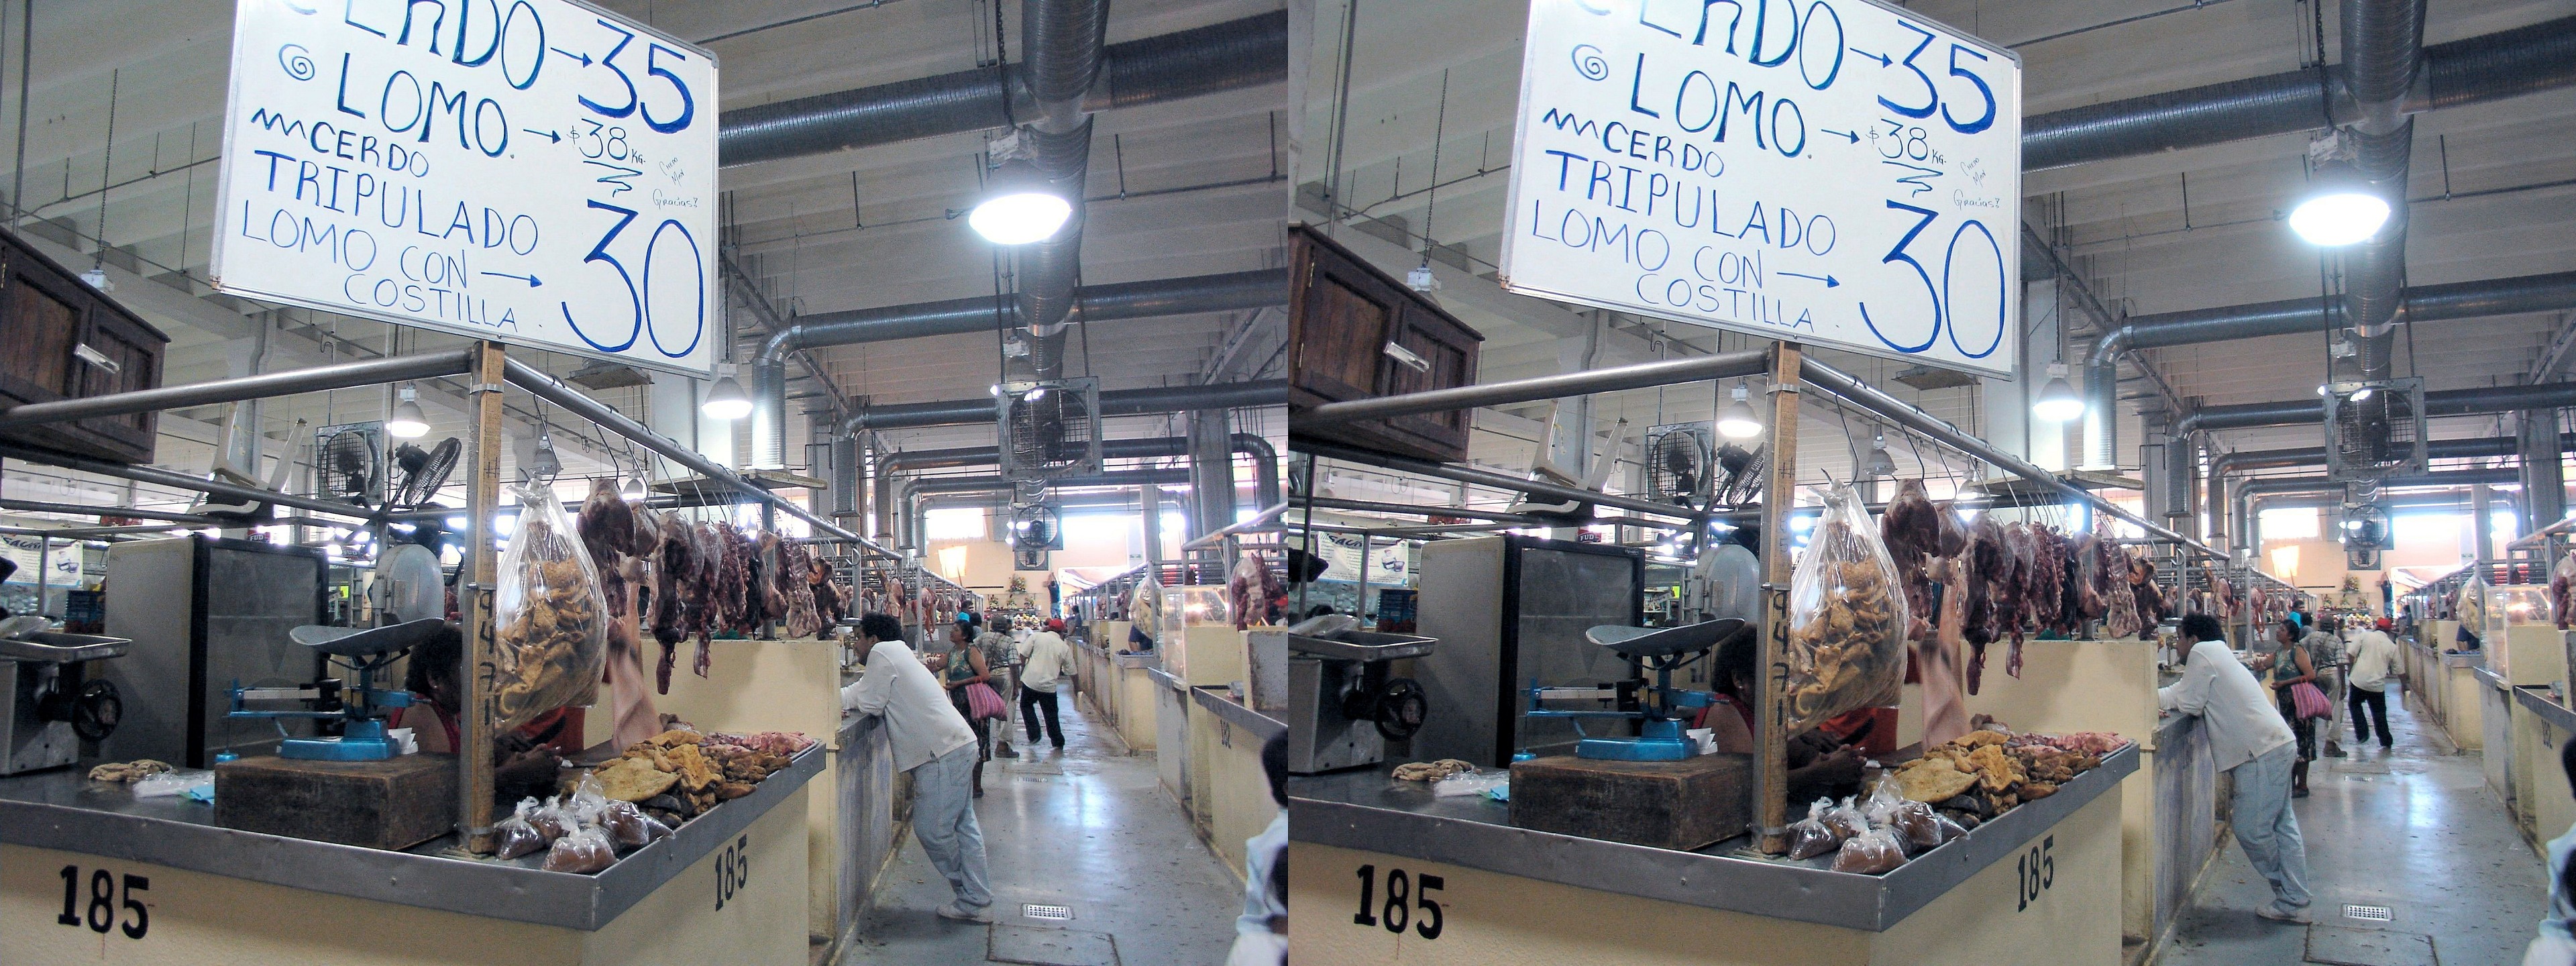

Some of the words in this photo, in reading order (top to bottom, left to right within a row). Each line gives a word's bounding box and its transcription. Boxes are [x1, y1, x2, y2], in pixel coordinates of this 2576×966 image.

[578, 19, 694, 134] 35
[1878, 19, 1996, 134] 35
[311, 121, 429, 177] CERDO
[1603, 121, 1724, 177] CERDO
[254, 150, 538, 256] TRIPULADO
[1546, 150, 1836, 256] TRIPULADO
[243, 200, 376, 271] LOMO
[400, 246, 467, 288] CON
[561, 199, 704, 358] 30
[345, 274, 517, 332] COSTILLA
[1533, 200, 1669, 271] LOMO
[1695, 246, 1762, 288] CON
[1860, 199, 2005, 359] 30
[1637, 274, 1814, 333] COSTILLA
[58, 865, 149, 939] 185
[715, 833, 747, 912] 185
[1354, 864, 1444, 939] 185
[2018, 834, 2053, 912] 185
